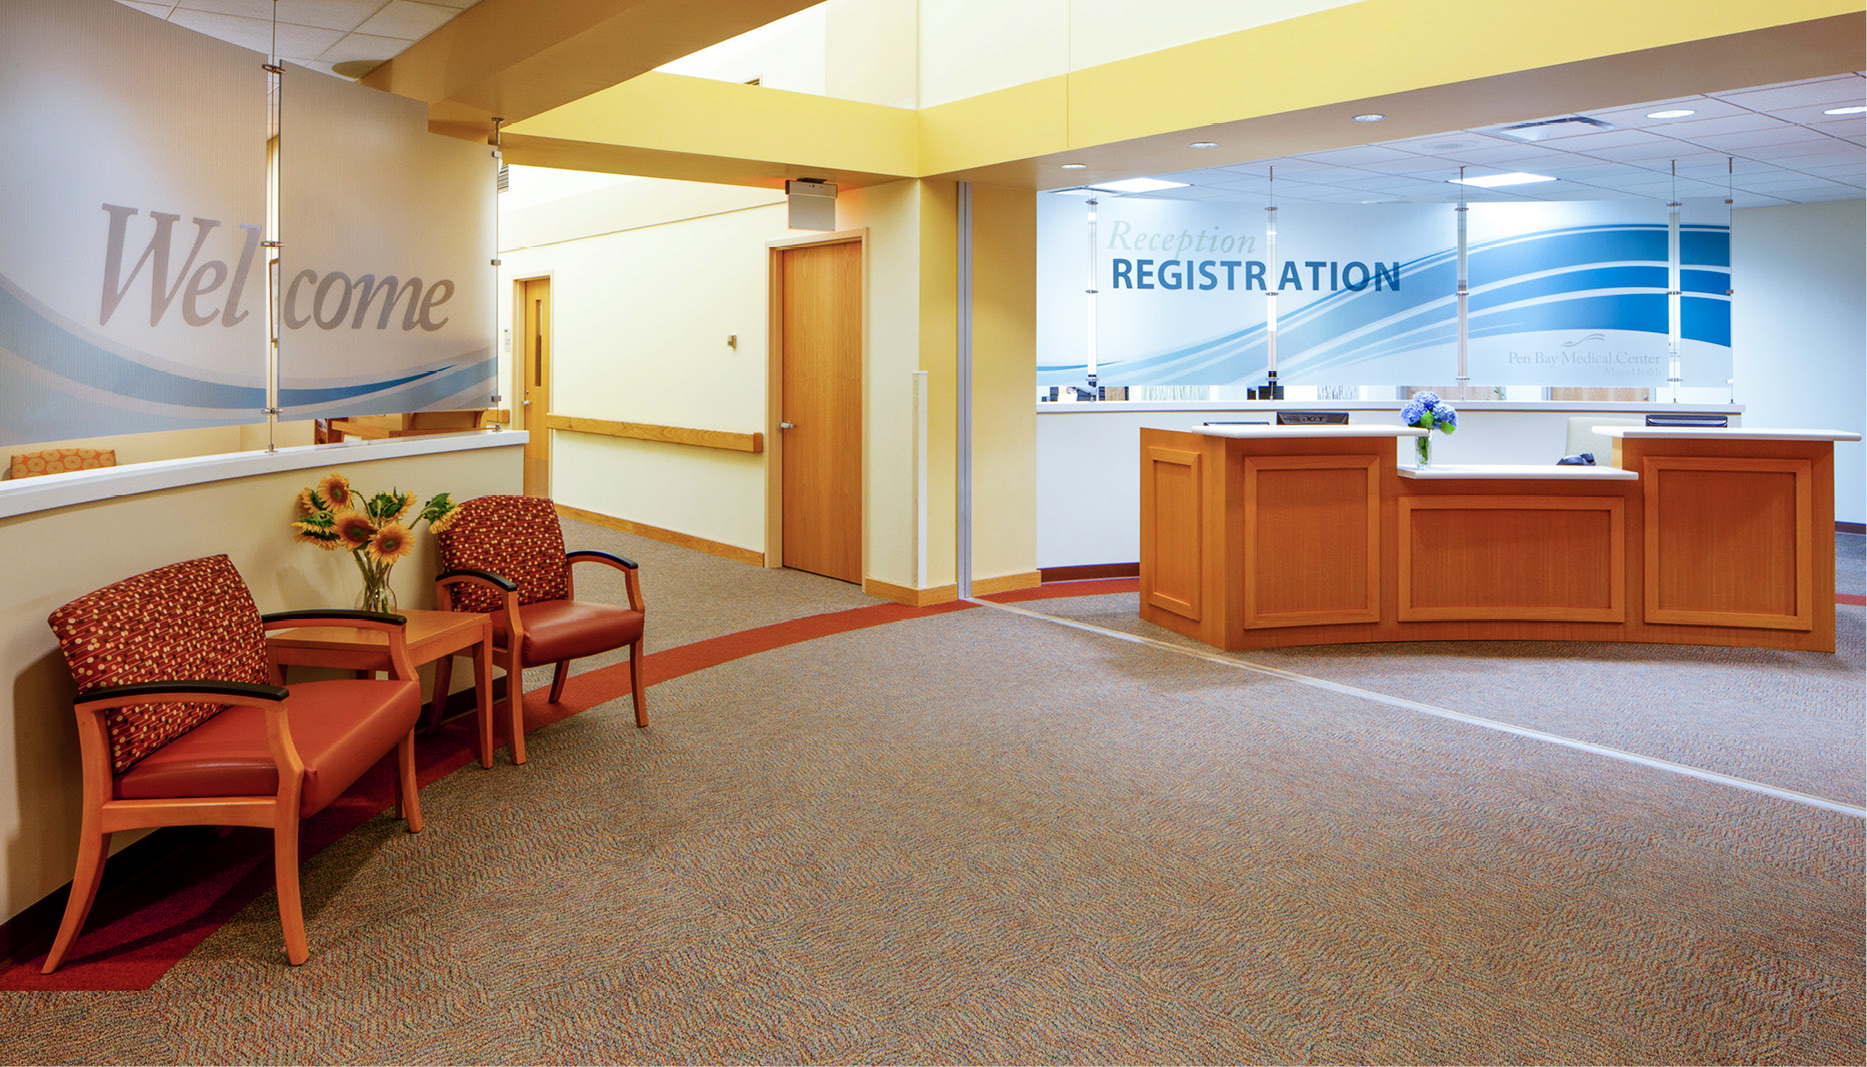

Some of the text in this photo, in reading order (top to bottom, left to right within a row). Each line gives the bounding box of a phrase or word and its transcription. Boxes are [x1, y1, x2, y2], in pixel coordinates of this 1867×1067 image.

[1106, 220, 1256, 260] Reception
[99, 203, 455, 332] Welcome
[1112, 258, 1400, 292] REGISTRATION
[1508, 351, 1662, 368] Pen Bay Medical Center
